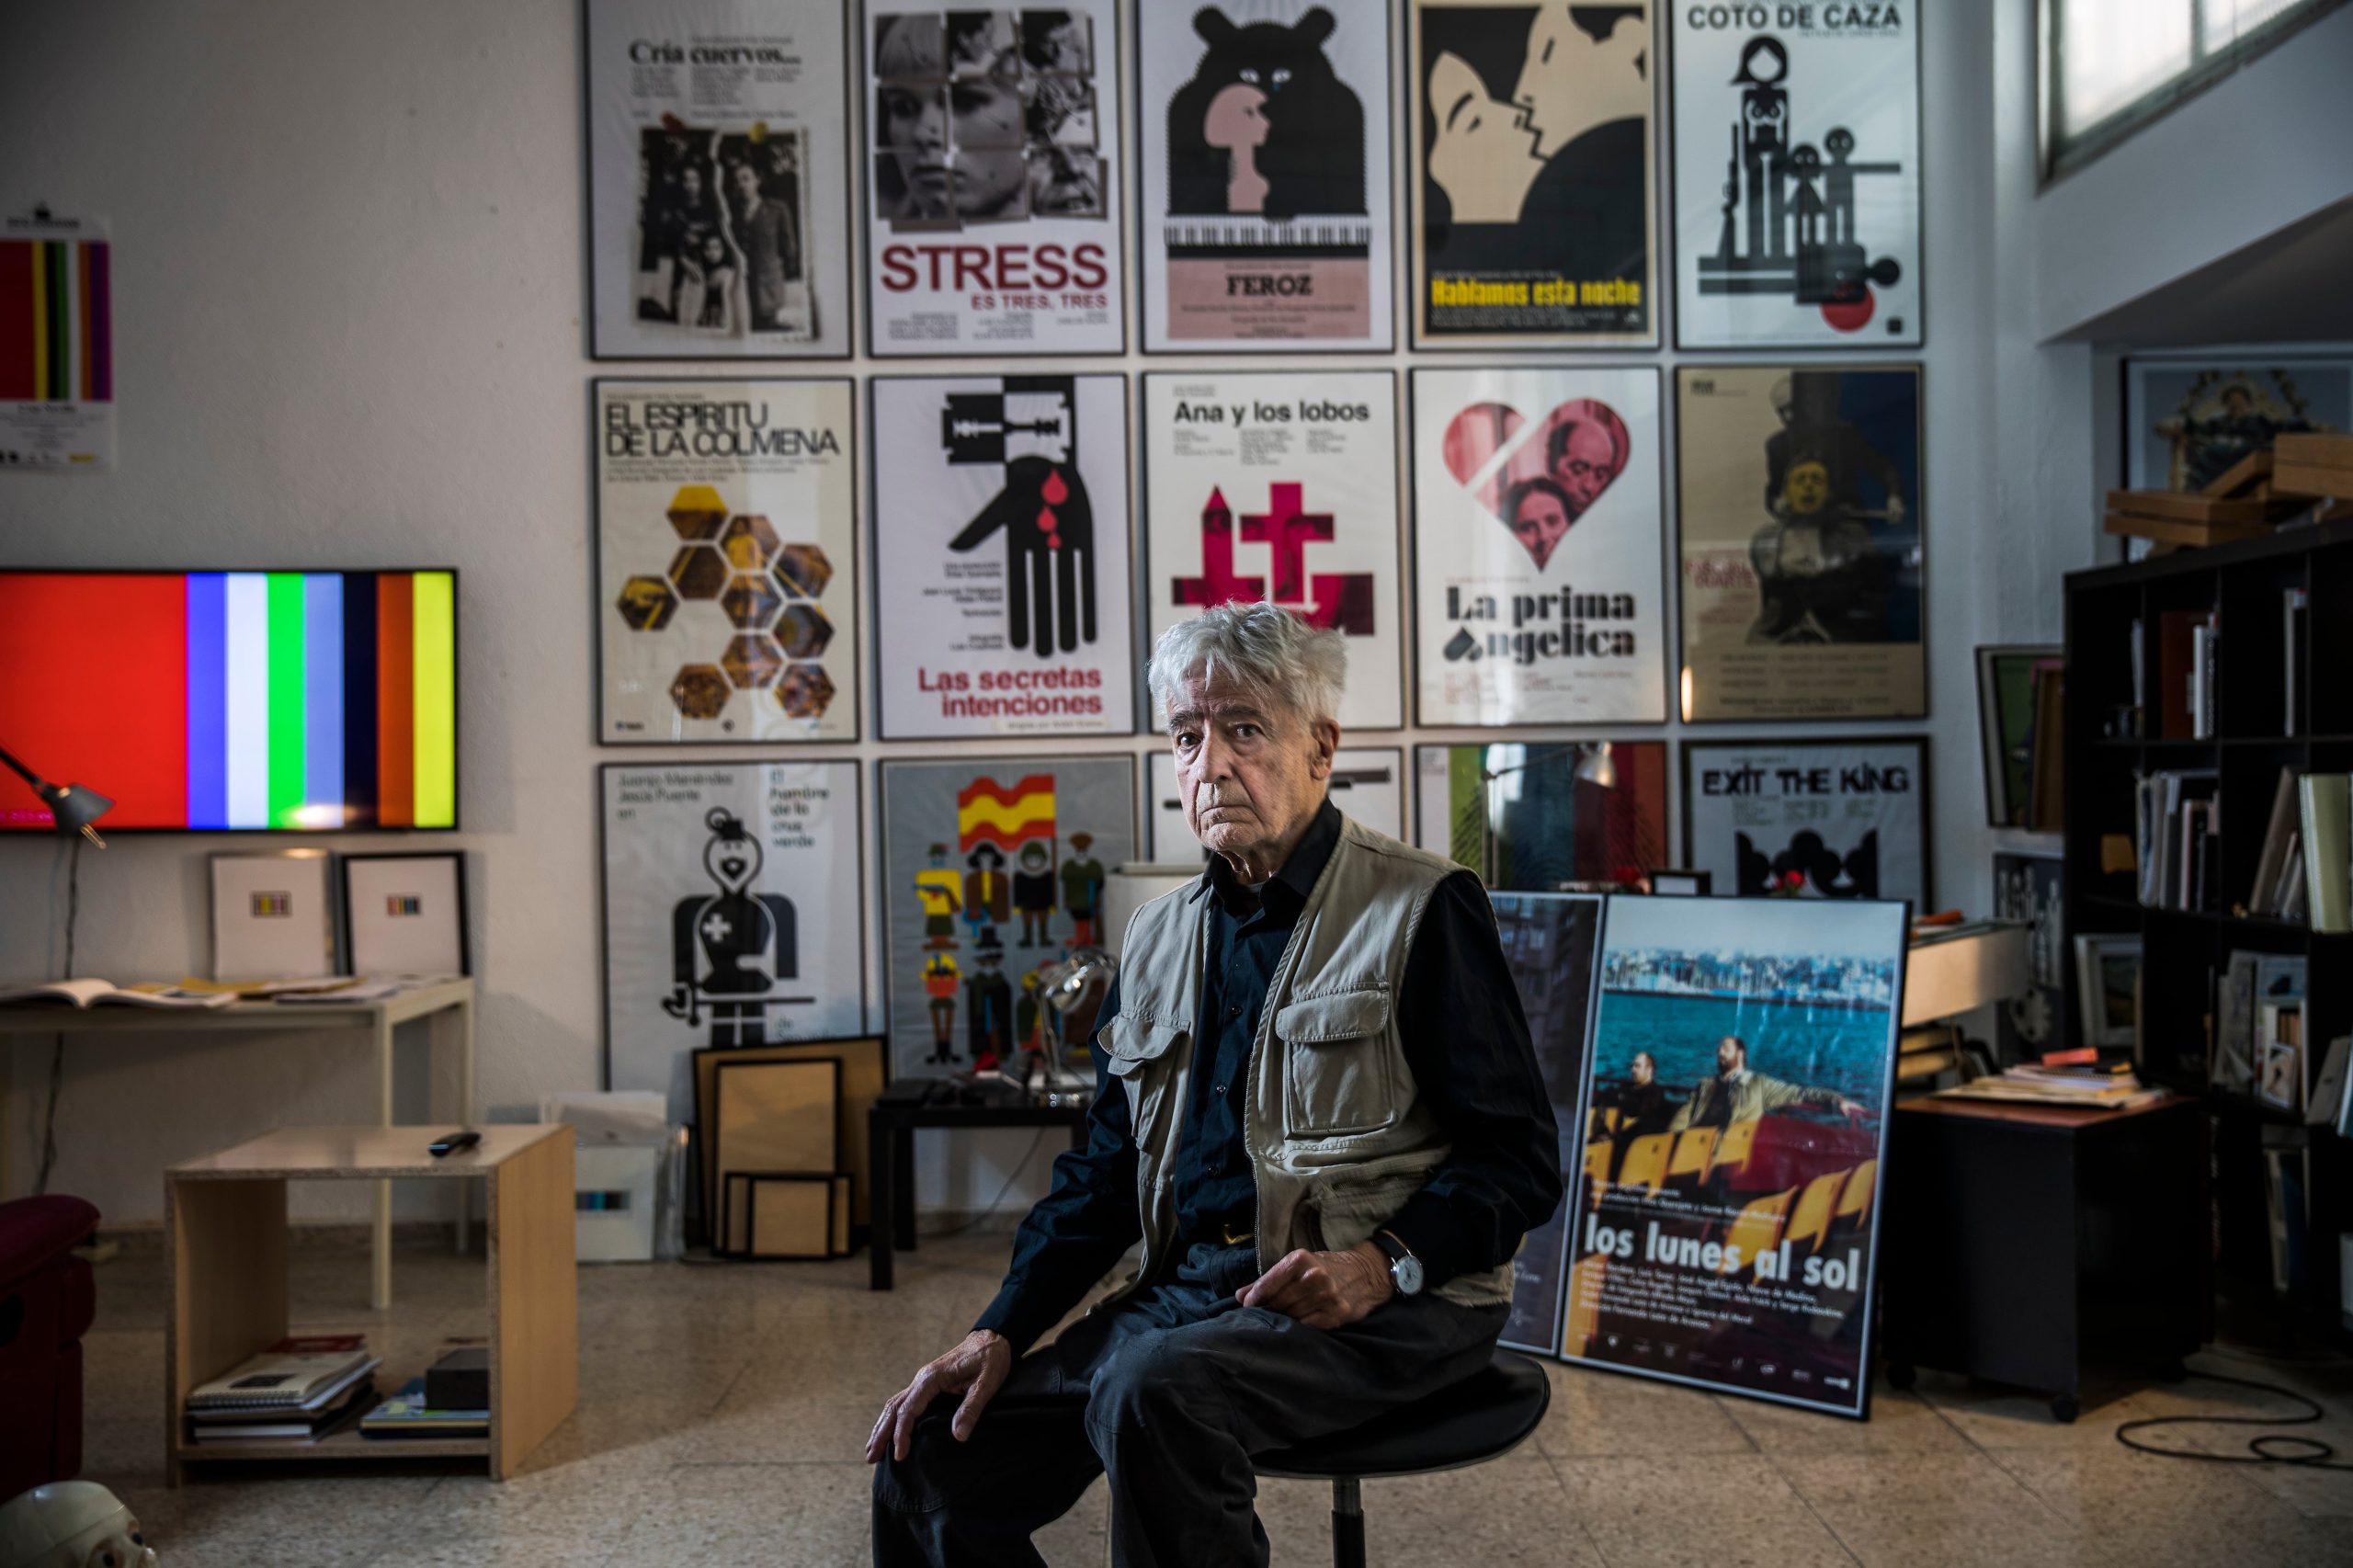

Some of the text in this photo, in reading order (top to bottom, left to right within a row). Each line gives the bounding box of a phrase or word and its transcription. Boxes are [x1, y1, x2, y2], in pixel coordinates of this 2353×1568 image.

[1688, 4, 1902, 29] COTO DE CAZA
[881, 243, 1108, 292] STRESS
[1225, 274, 1314, 296] FEROZ
[1431, 275, 1642, 307] Hablamos esta noche
[971, 292, 1108, 312] ES TRES, TRES
[606, 402, 768, 431] EL ESPIRITU
[1174, 398, 1370, 428] Ana y los lobos
[606, 427, 840, 457] DE LA COLMENA
[1447, 585, 1636, 628] La prima
[918, 665, 1102, 692] Las secretas
[941, 691, 1103, 718] intenciones
[1775, 767, 1831, 795] THE
[1583, 1211, 1861, 1292] los lunes al sol
